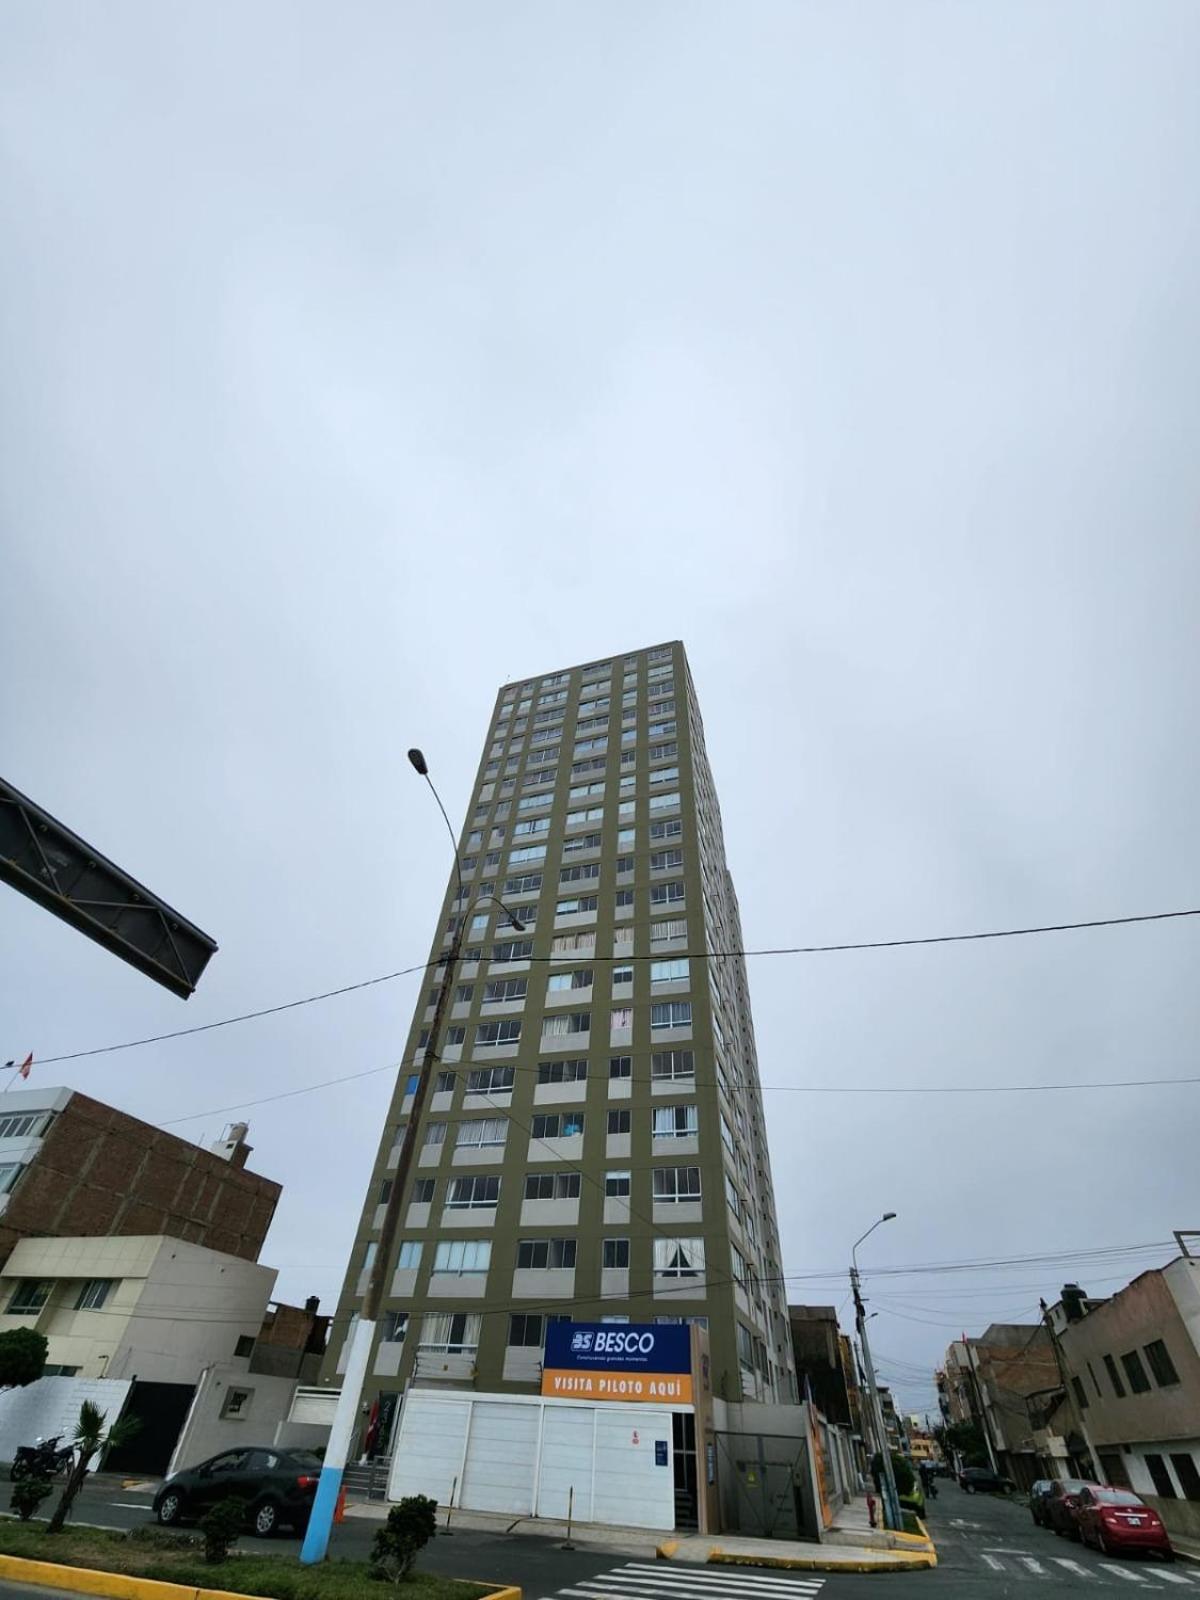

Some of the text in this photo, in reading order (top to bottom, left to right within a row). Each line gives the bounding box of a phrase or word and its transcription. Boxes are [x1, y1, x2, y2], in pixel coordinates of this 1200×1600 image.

[594, 1332, 655, 1353] BESCO
[554, 1376, 682, 1397] VISITA PILOTO AQUÍ
